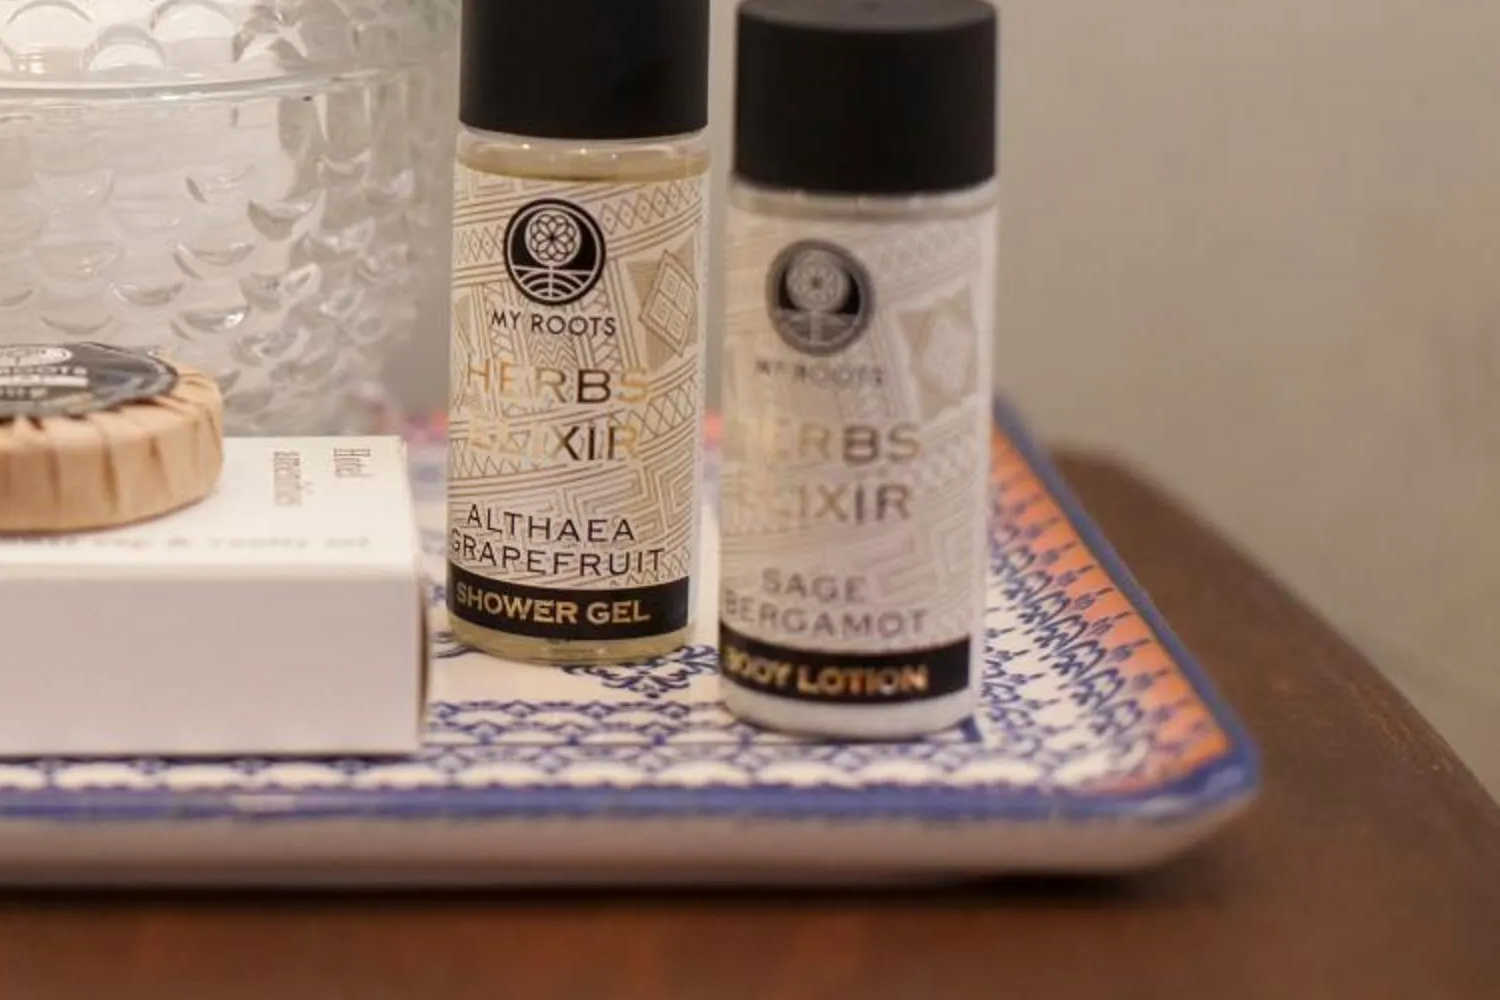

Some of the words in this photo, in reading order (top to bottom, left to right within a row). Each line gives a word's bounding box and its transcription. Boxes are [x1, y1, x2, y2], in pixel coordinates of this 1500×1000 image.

[491, 311, 521, 331] MY
[531, 314, 617, 337] ROOTS
[468, 418, 639, 461] XIR
[467, 503, 635, 543] ALTHAEA
[738, 481, 911, 524] IXIR
[451, 527, 665, 577] GRAPEFRUIT
[456, 581, 578, 624] SHOWER
[587, 600, 650, 625] GEL
[762, 567, 867, 604] SAGE
[724, 587, 928, 638] BERGAMOT
[798, 663, 928, 695] LOTION
